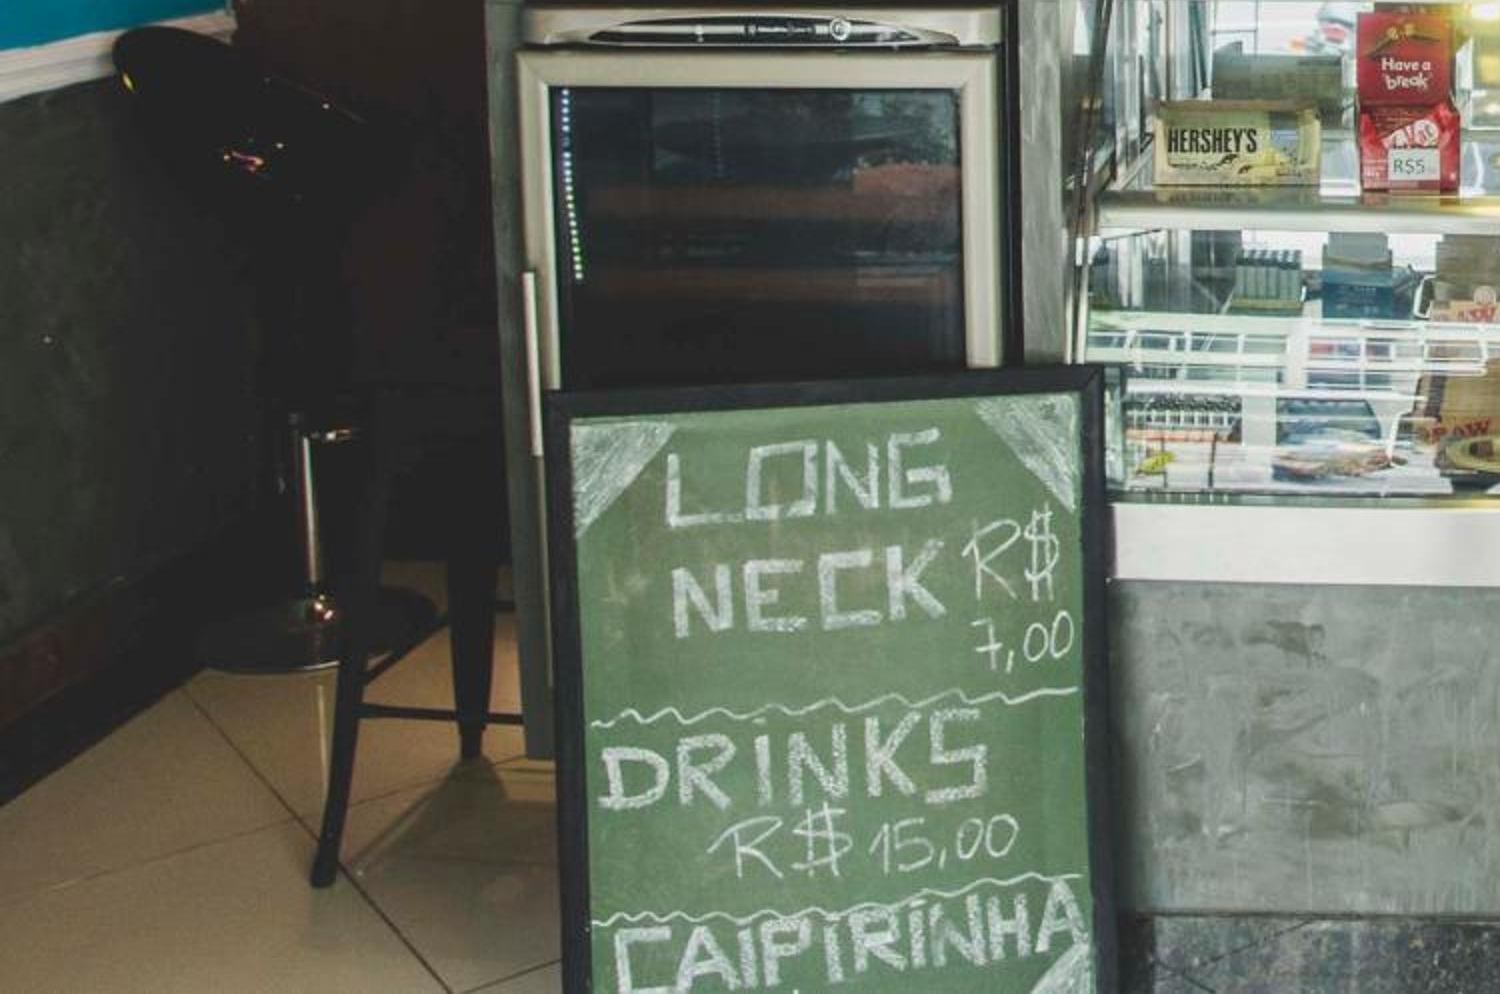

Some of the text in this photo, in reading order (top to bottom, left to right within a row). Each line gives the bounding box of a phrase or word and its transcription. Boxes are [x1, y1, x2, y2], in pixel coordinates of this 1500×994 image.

[1381, 57, 1419, 72] Have
[1385, 73, 1430, 90] break
[1167, 127, 1257, 153] HERSHEY'S
[665, 427, 954, 528] LONG
[671, 504, 1060, 639] NECK R$
[969, 609, 1076, 674] 7,00
[599, 707, 989, 811] DRINKS
[707, 801, 1020, 879] R$ 15,00
[614, 877, 1090, 994] CAIPIRINHA
